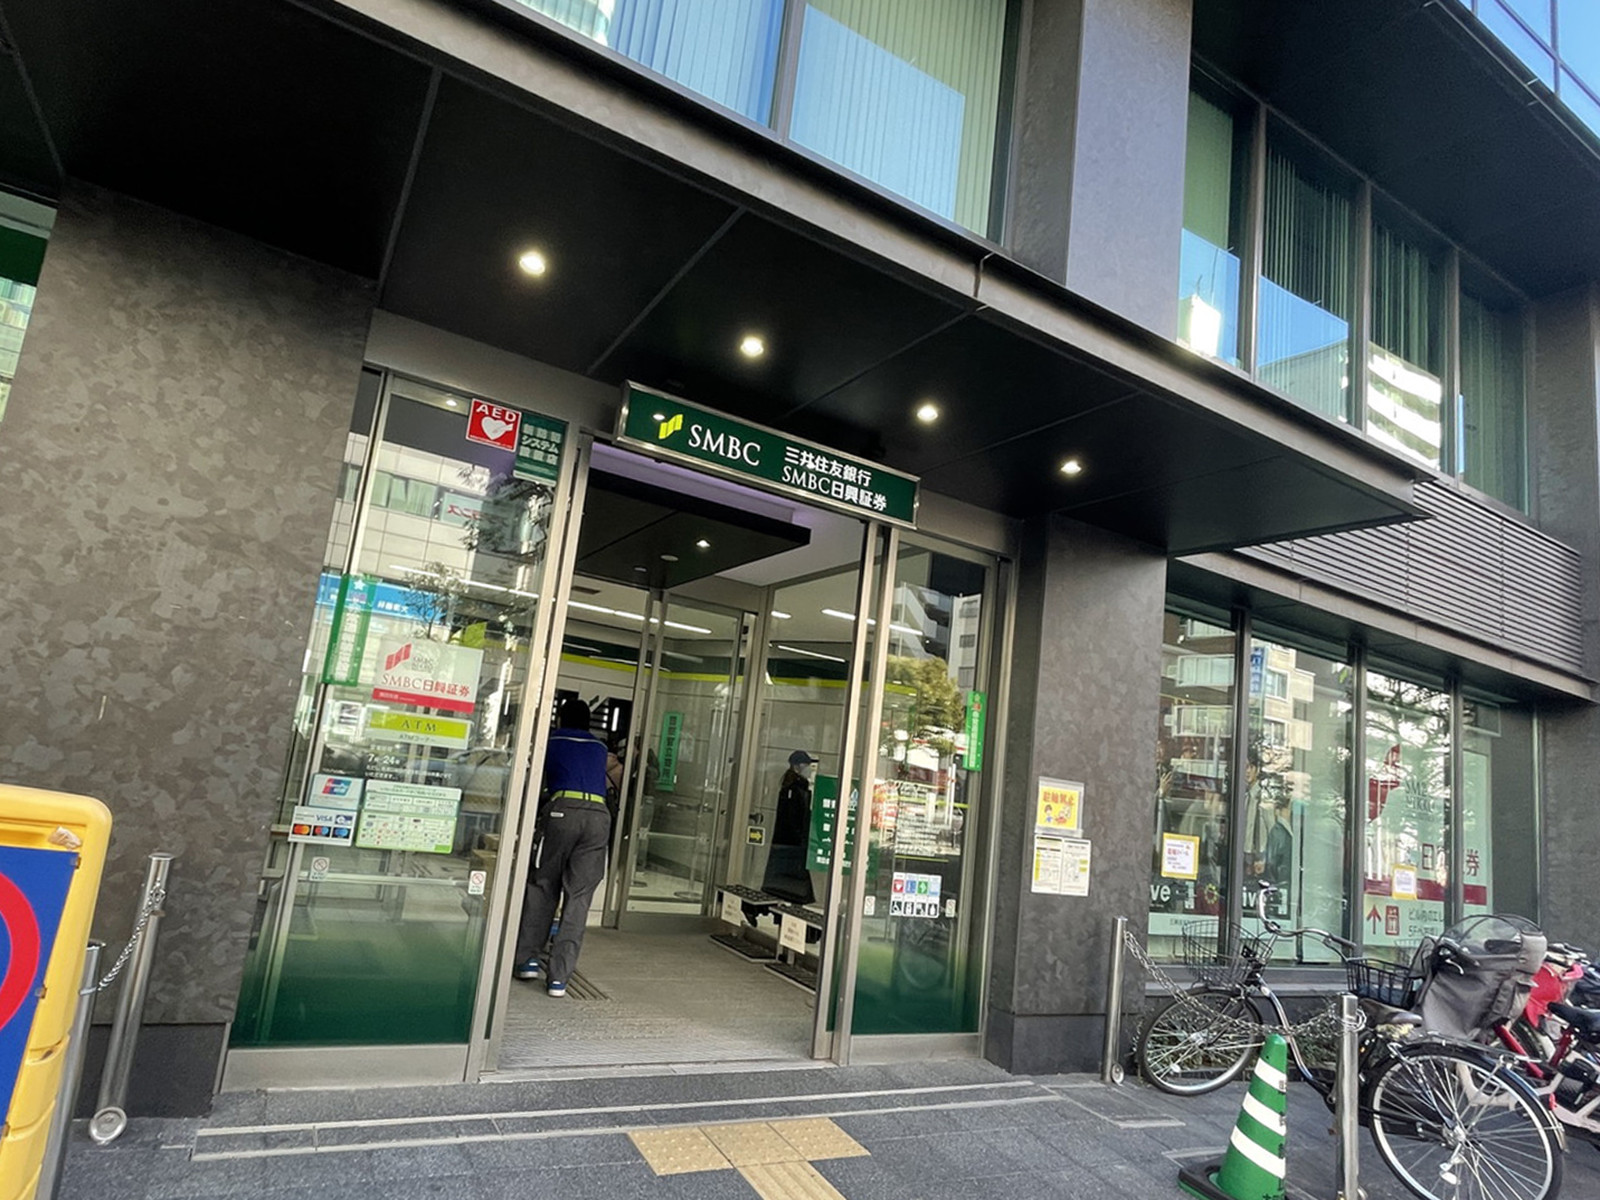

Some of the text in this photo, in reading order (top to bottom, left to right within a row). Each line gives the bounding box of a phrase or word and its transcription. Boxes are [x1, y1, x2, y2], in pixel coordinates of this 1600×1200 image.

[476, 404, 517, 422] AED
[521, 435, 560, 455] システム
[688, 424, 761, 466] SMBC
[784, 446, 872, 487] 三井住友銀行
[782, 465, 887, 511] SMBC日興証券
[381, 673, 470, 698] SMBC日興証券
[402, 719, 437, 732] ATM
[315, 814, 333, 823] VISA
